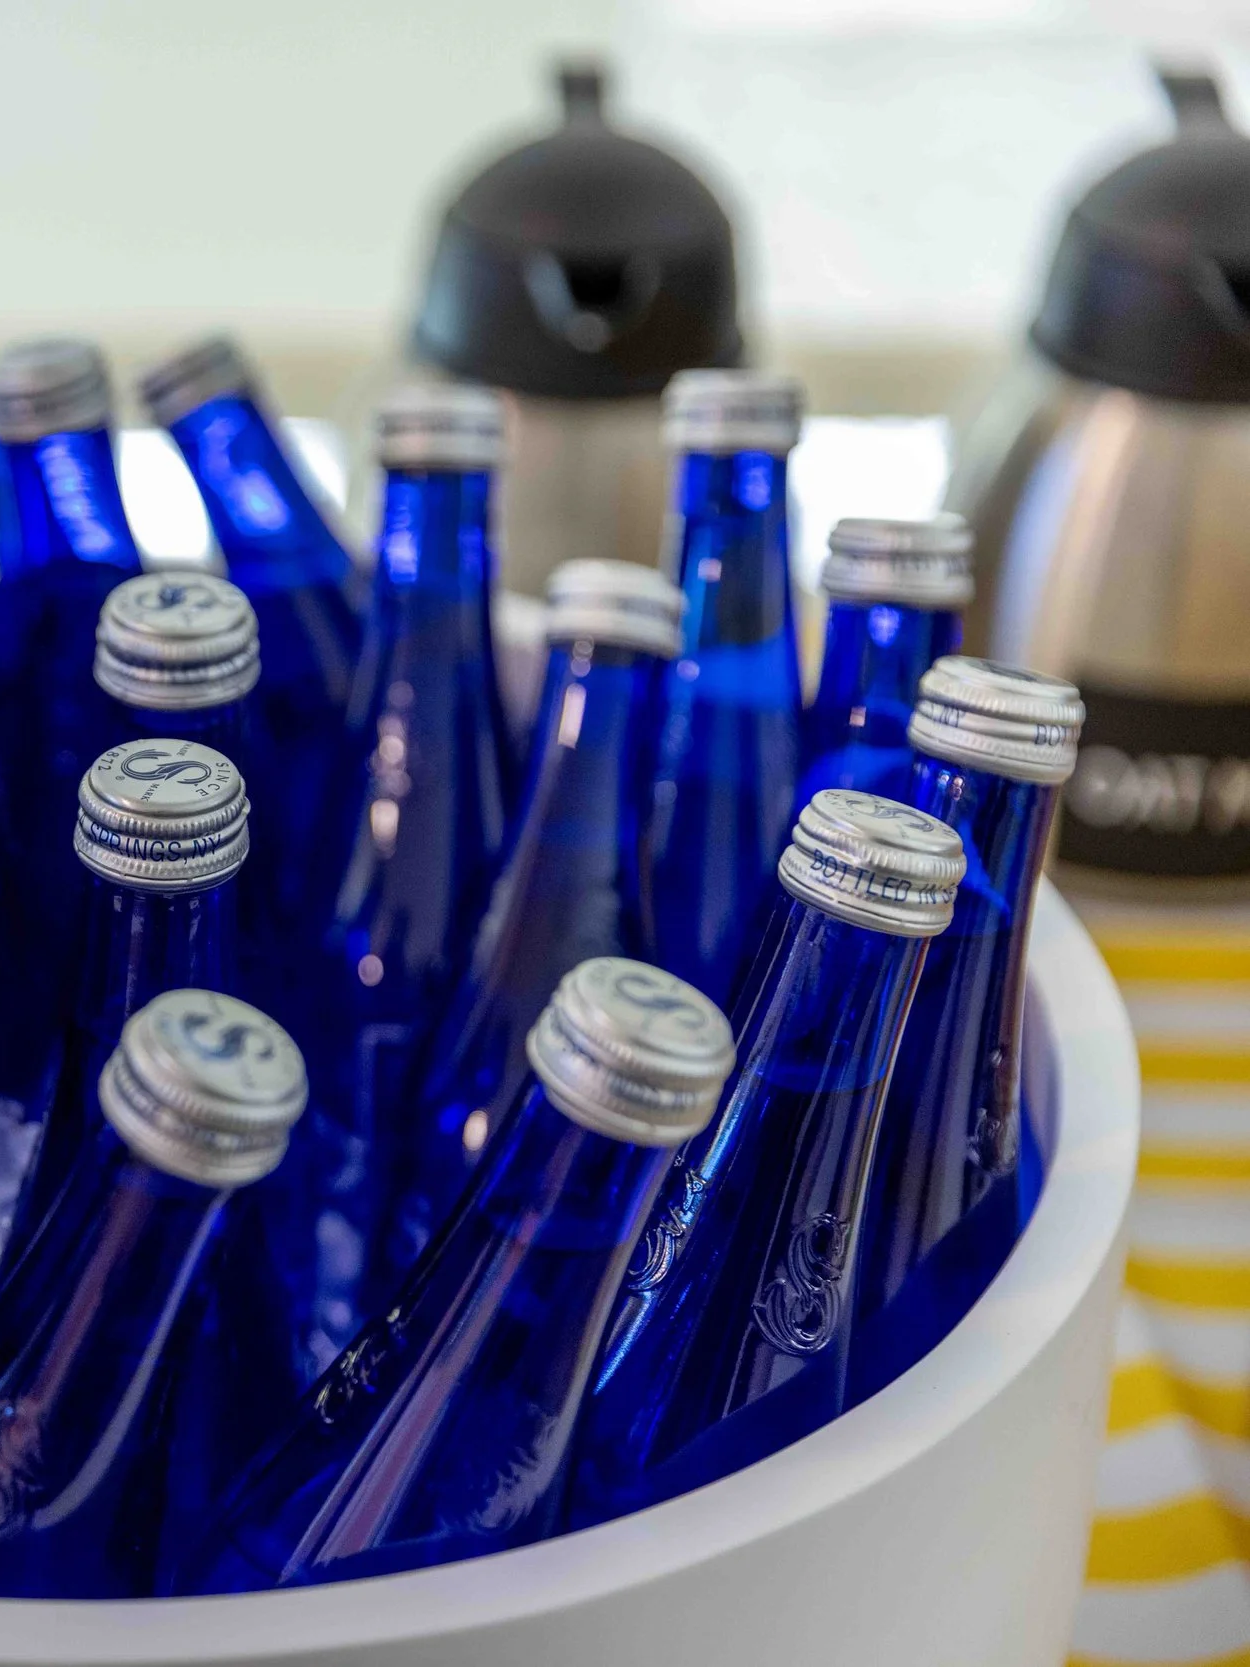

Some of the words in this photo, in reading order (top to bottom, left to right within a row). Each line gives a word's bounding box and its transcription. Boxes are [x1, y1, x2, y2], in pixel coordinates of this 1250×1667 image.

[97, 746, 128, 772] 1872
[195, 761, 231, 797] SINCE
[810, 848, 912, 902] BOTTLED
